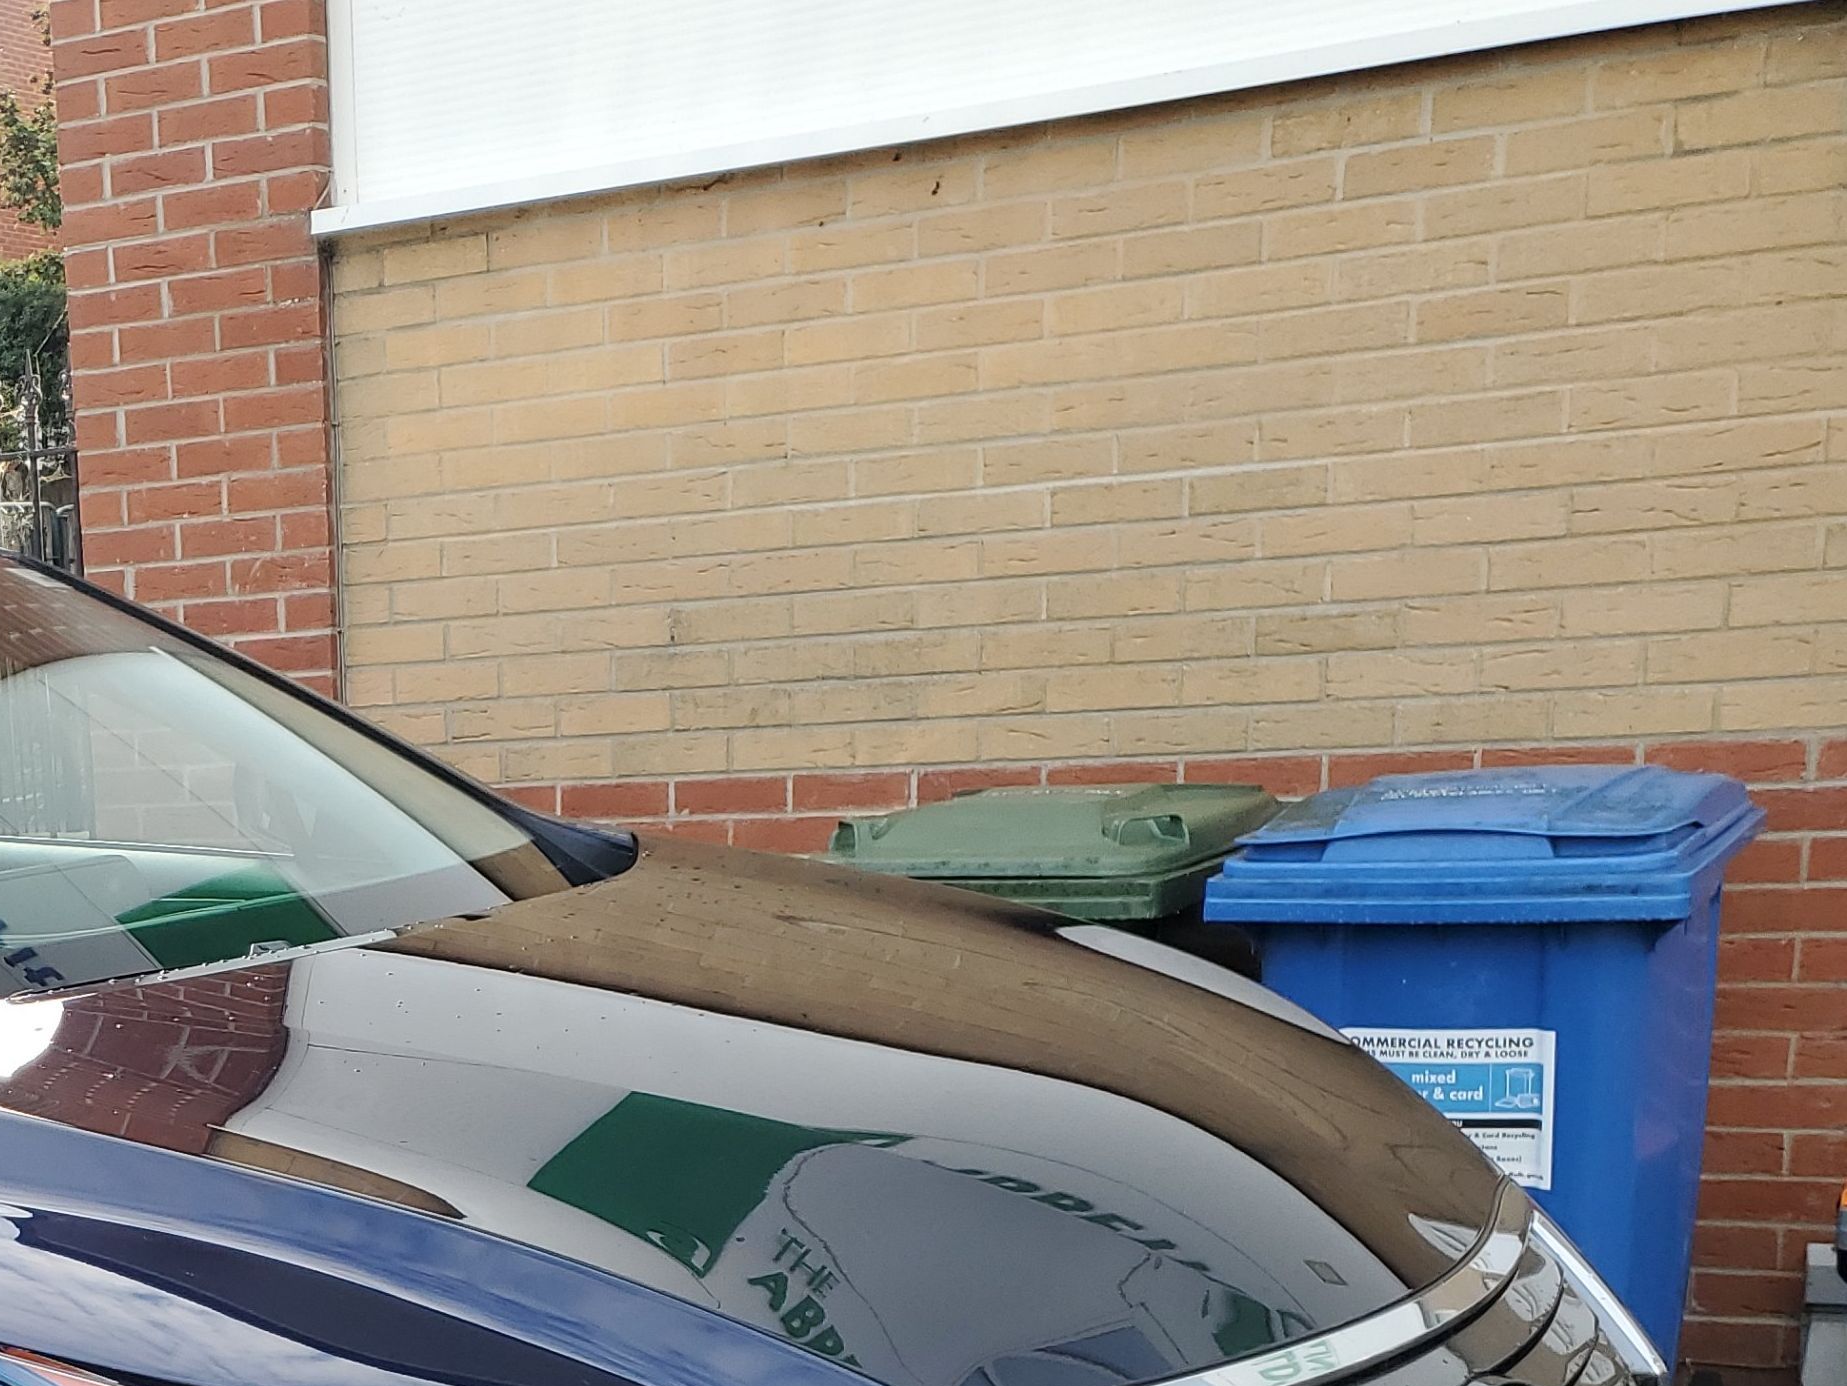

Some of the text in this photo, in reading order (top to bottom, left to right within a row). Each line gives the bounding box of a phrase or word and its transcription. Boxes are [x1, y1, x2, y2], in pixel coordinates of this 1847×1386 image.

[1350, 1036, 1534, 1049] OMMERCIAL RECYCLING
[1379, 1049, 1405, 1058] MUST
[1408, 1050, 1419, 1058] BE
[1422, 1050, 1457, 1059] CLEAN,
[1460, 1050, 1480, 1058] DRY
[1494, 1049, 1529, 1058] LOOSE
[1411, 1069, 1456, 1084] mixed
[1433, 1086, 1444, 1100] &
[1449, 1085, 1483, 1101] card
